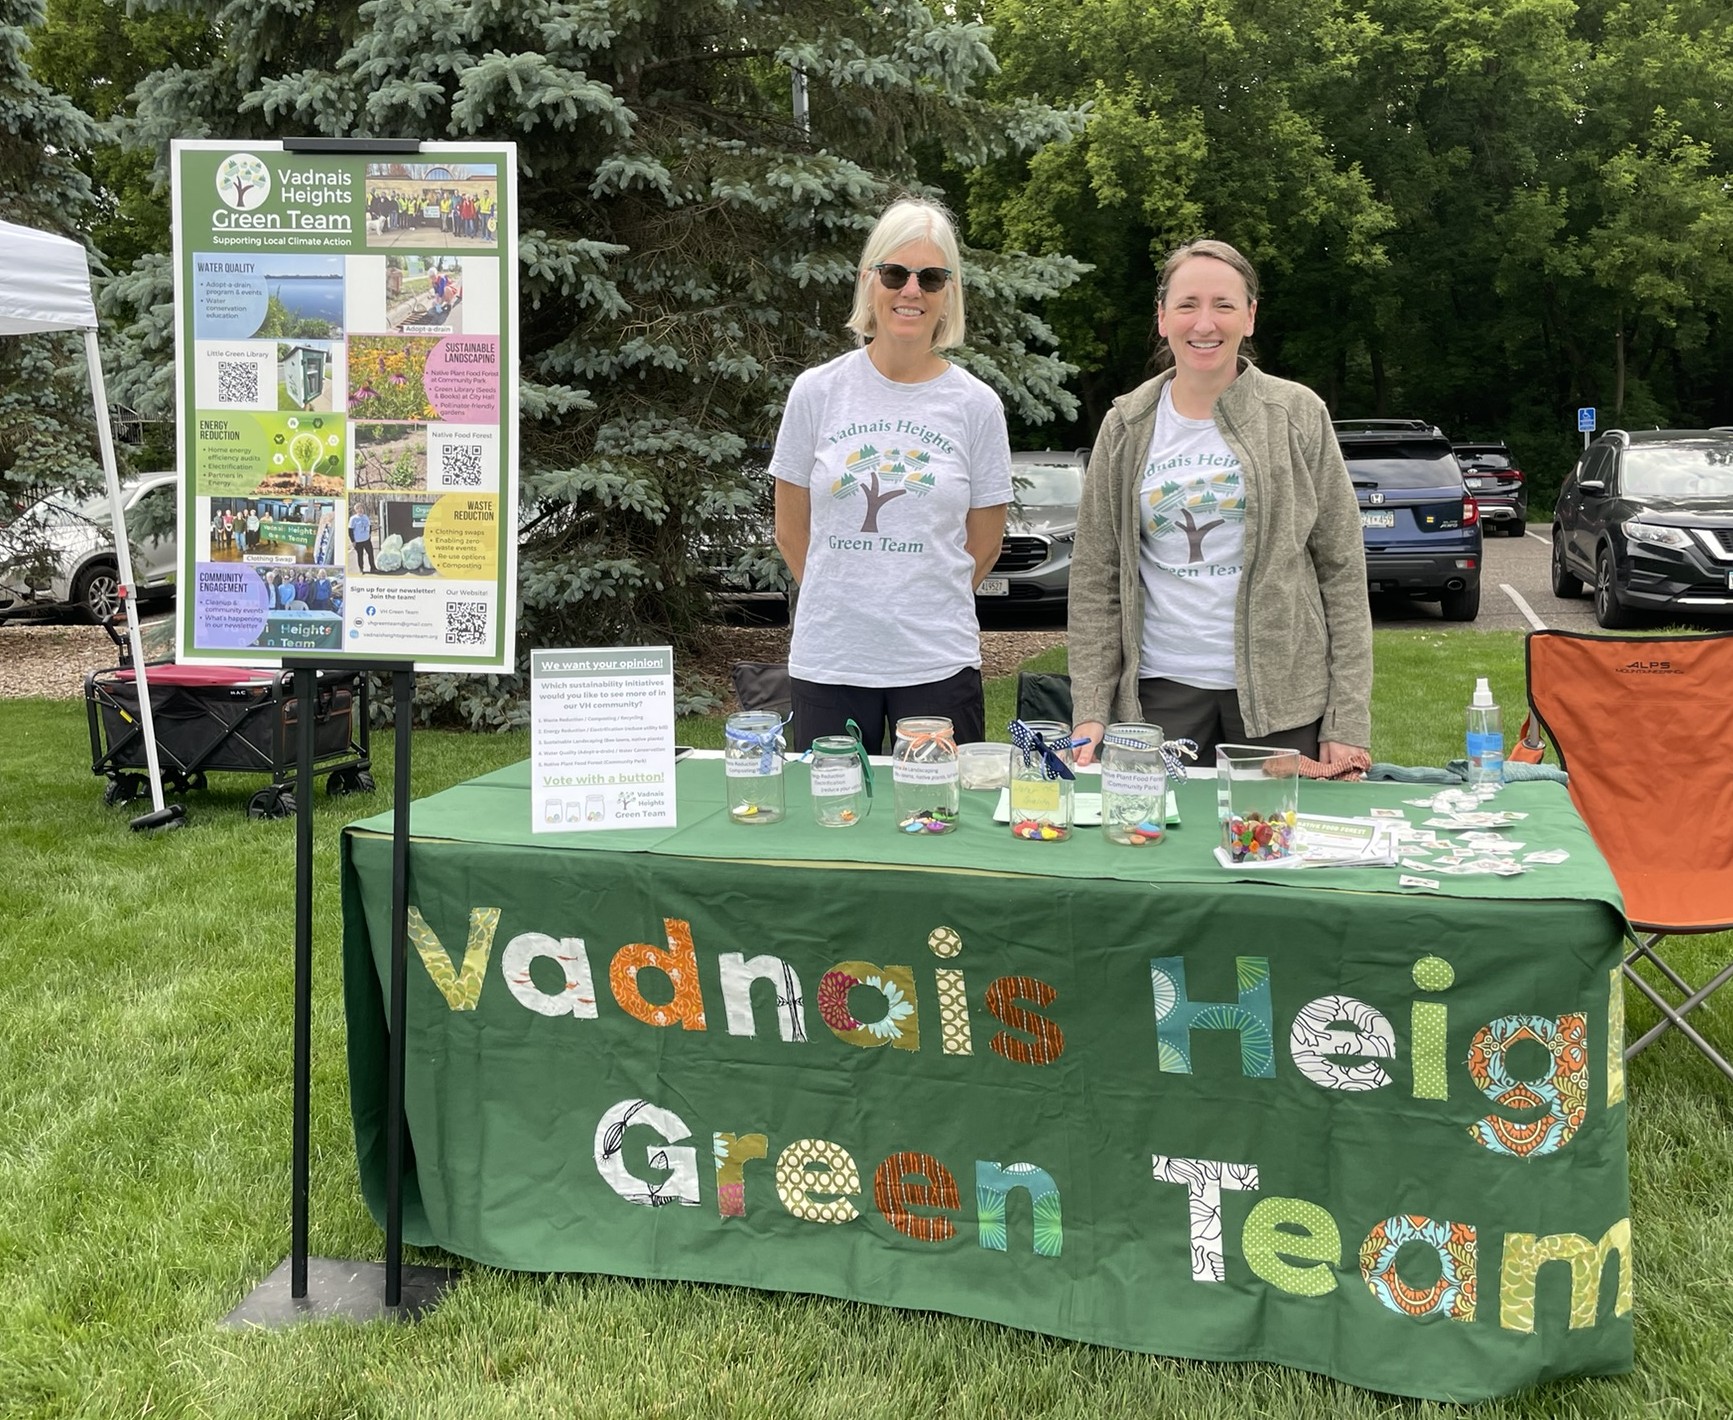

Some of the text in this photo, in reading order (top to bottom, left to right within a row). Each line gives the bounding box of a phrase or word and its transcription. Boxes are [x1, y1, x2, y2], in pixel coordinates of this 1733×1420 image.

[277, 169, 352, 185] Vadnais
[281, 187, 352, 207] Heights
[212, 209, 351, 229] Green Team
[212, 235, 352, 247] Supporting Local Climate Action
[197, 262, 255, 273] WATER QUALITY
[445, 342, 495, 353] SUSTAINABLE
[246, 351, 269, 359] Library
[444, 353, 495, 364] LANDSCAPING
[200, 420, 228, 430] ENERGY
[200, 430, 240, 441] REDUCTION
[896, 419, 954, 455] Heights
[1198, 453, 1241, 468] Heig
[467, 501, 492, 510] WASTE
[454, 511, 494, 521] REDUCTION
[829, 535, 924, 553] Green Team
[246, 555, 273, 563] Clothing
[199, 572, 244, 581] COMMUNITY
[199, 582, 248, 593] ENGAGEMENT
[350, 586, 365, 594] Sign
[281, 623, 332, 637] Heights
[280, 638, 315, 648] Team
[541, 658, 663, 671] We want your opinion!
[1626, 661, 1671, 669] ALPS
[541, 679, 664, 689] Which sustainability initiatives
[539, 692, 565, 700] would
[593, 701, 643, 709] community?
[543, 772, 665, 786] Vote with a button!
[1132, 774, 1149, 782] Food
[615, 810, 666, 819] Green Team
[1322, 824, 1340, 832] FOOD
[1340, 826, 1366, 835] FOREST
[407, 906, 1064, 1066] Vadnais
[594, 1099, 1633, 1334] Green Team
